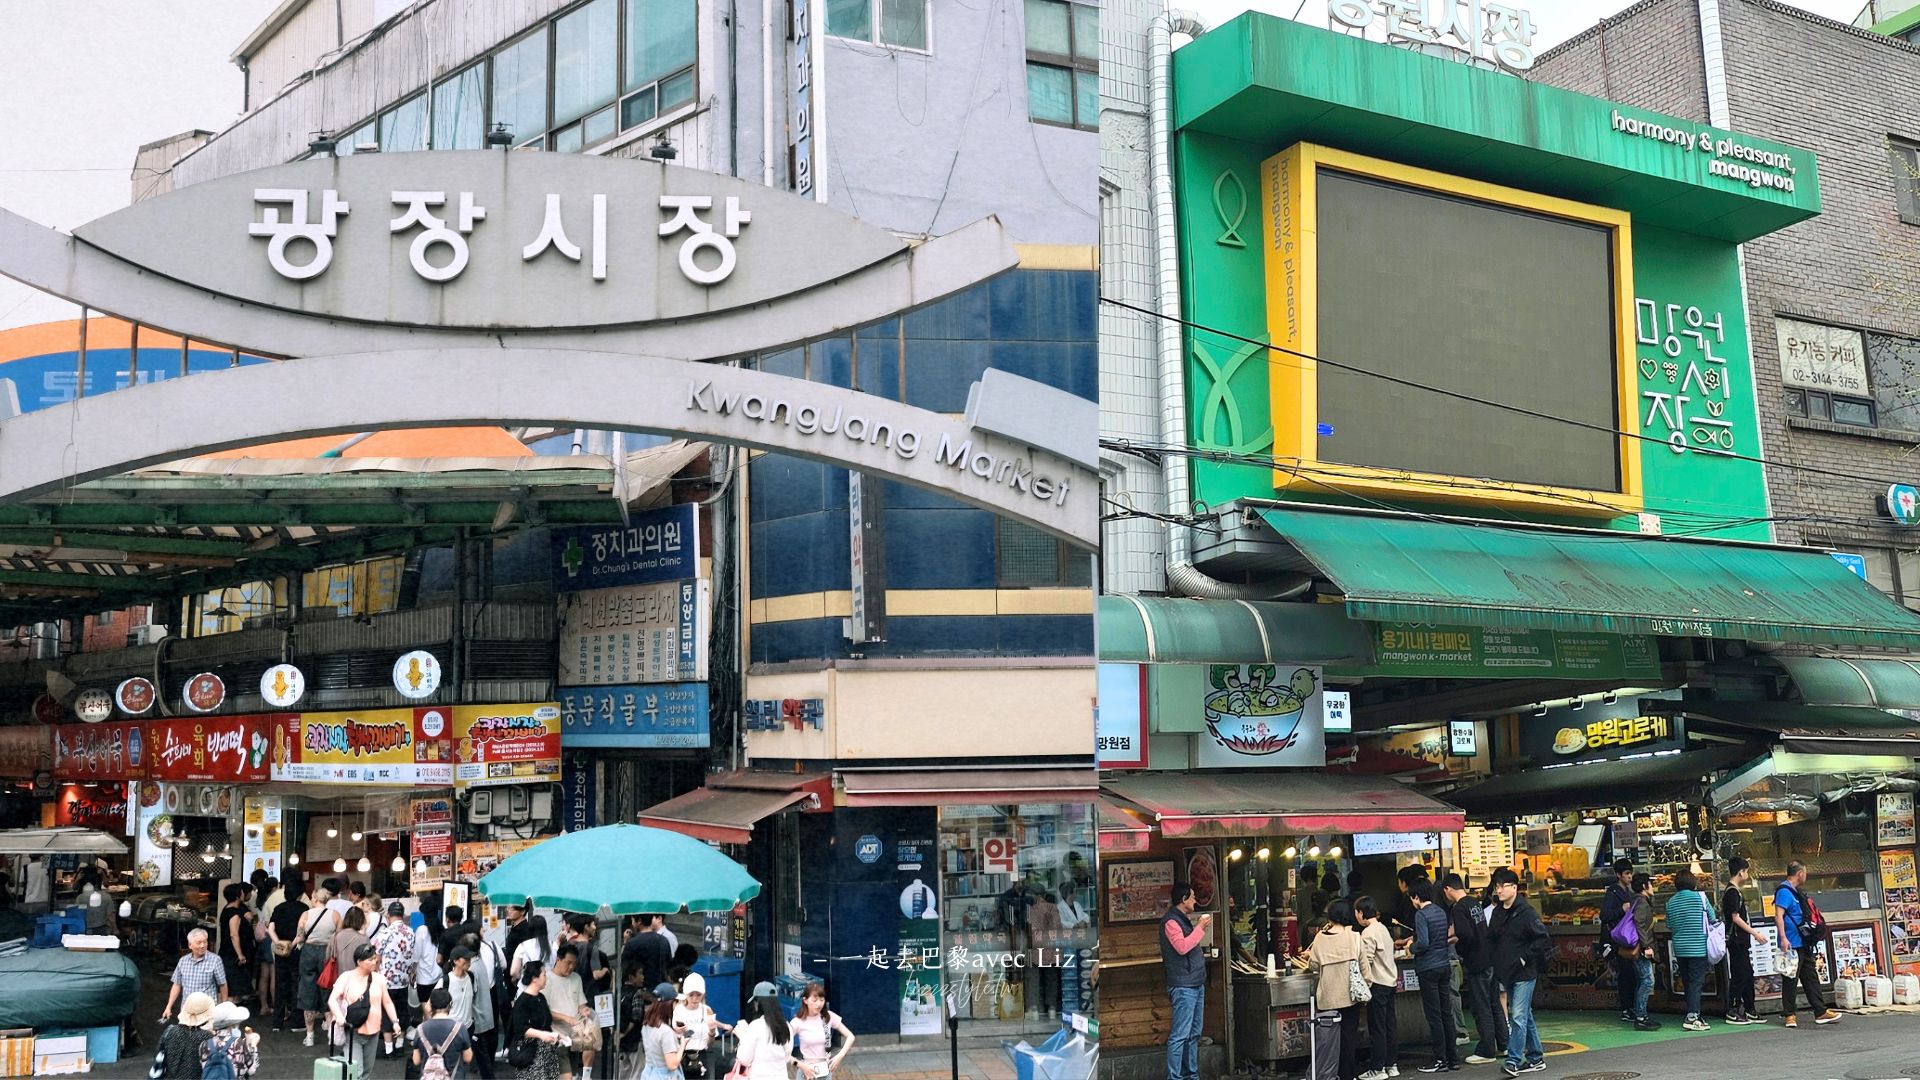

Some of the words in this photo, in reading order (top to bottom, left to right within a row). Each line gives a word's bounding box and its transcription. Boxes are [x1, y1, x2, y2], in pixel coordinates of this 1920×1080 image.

[1611, 109, 1696, 151] harmony
[1698, 132, 1714, 153] &
[1716, 137, 1796, 175] pleasant,
[1709, 158, 1795, 193] mangwon
[1271, 160, 1282, 250] mangwon
[1280, 158, 1292, 238] harmony
[248, 188, 752, 286] 광장시장
[1283, 259, 1298, 343] pleasant,
[1787, 337, 1826, 362] 유기농
[1830, 345, 1857, 367] 커피
[1793, 369, 1859, 390] 02-3144-3755
[687, 378, 923, 459] KwangJang
[935, 432, 1072, 508] Market
[591, 521, 681, 562] 정치과의원
[632, 558, 658, 570] Dental
[659, 556, 682, 566] Clinic
[1382, 630, 1472, 651] 용기내!캠페인
[1382, 651, 1427, 661] mangwon
[562, 693, 660, 727] 동문직물부
[193, 723, 205, 771] 육회
[206, 724, 247, 775] 빈대떡
[1099, 735, 1131, 751] 망원점
[1586, 716, 1668, 748] 망원고로케
[72, 728, 123, 773] 부산어묵
[859, 843, 878, 854] ADT
[984, 838, 1017, 872] 약
